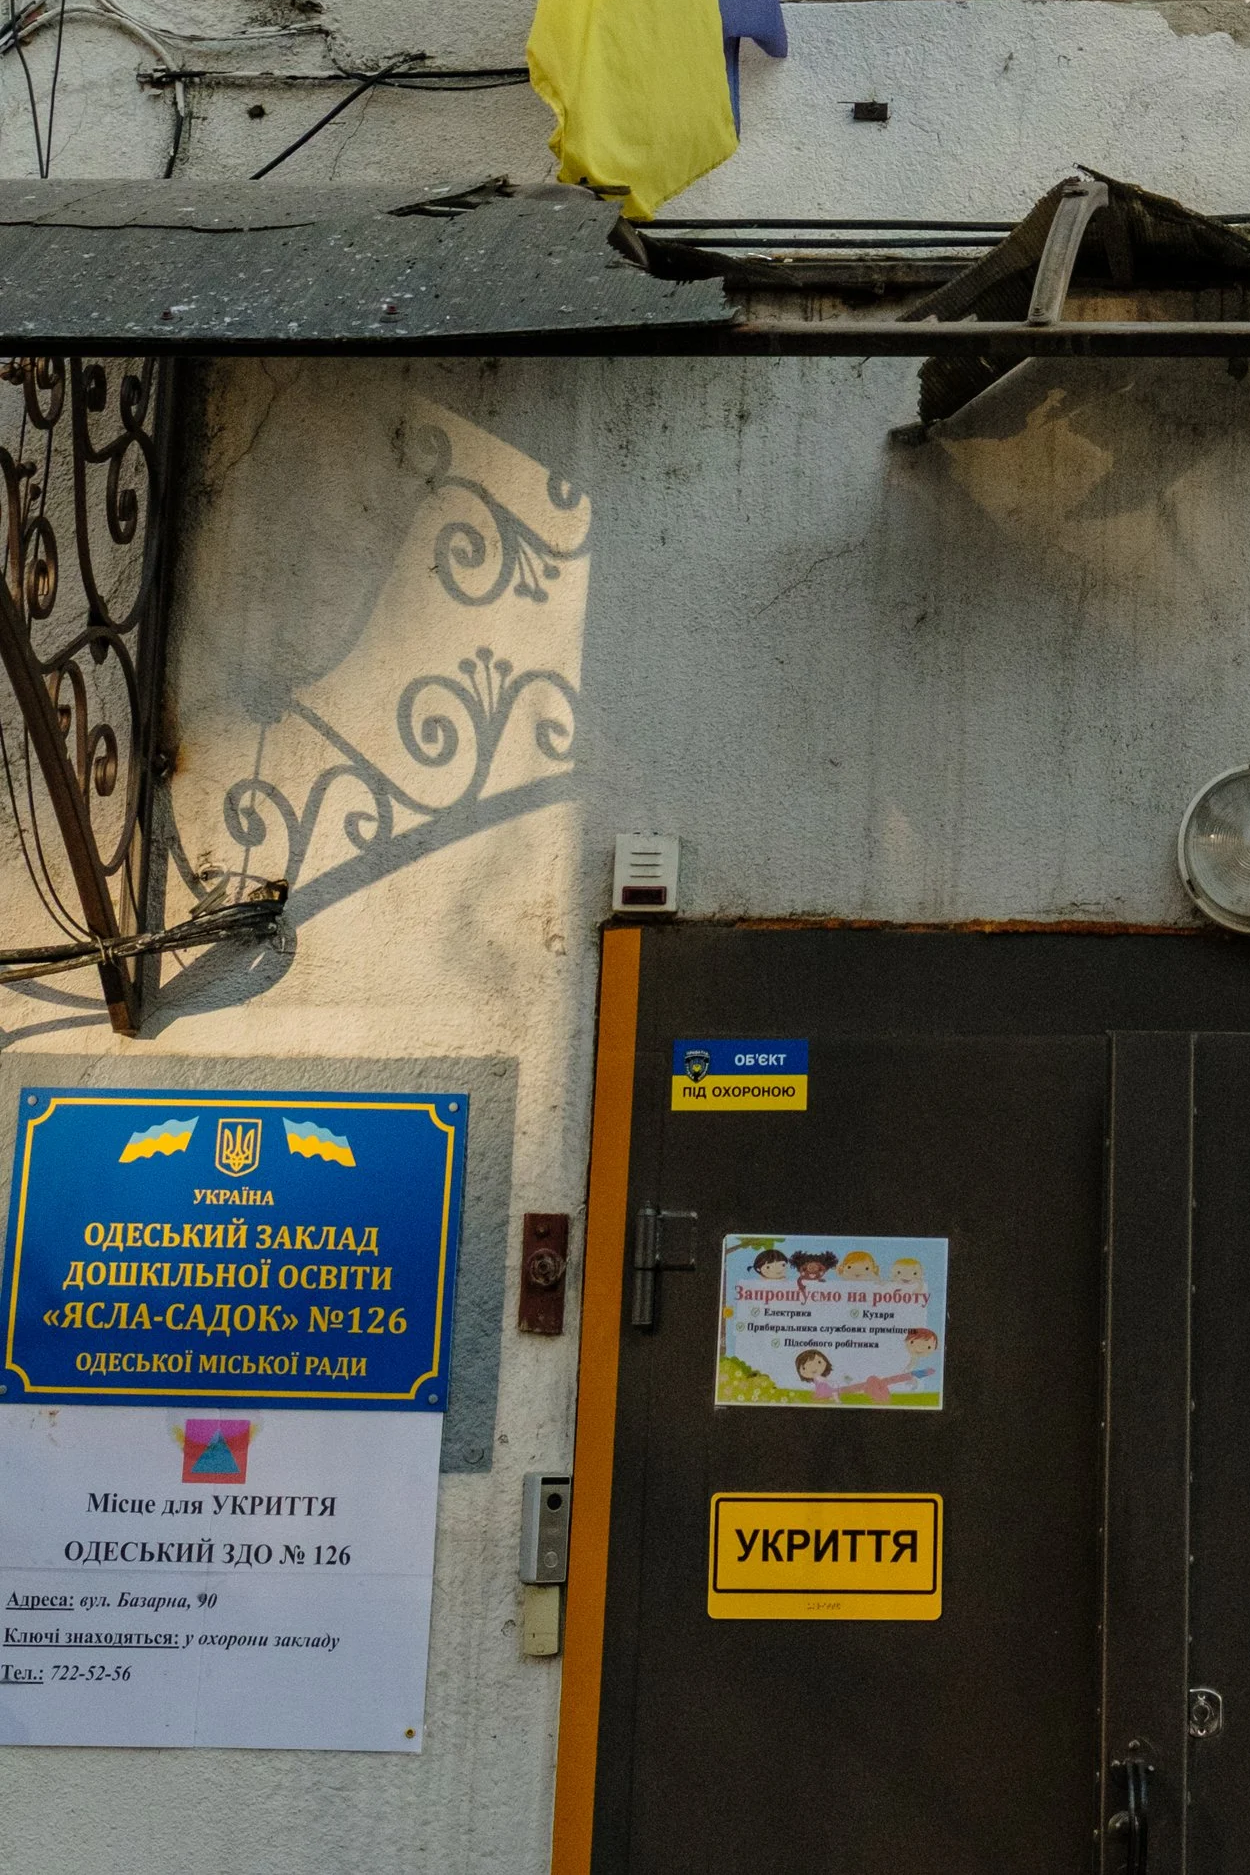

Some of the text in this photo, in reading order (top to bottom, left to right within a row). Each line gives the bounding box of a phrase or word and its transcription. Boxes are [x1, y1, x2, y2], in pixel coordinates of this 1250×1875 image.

[683, 1086, 796, 1099] ПІД ОХОРОНОЮ
[193, 1188, 275, 1207] УКРАЇНА
[84, 1218, 379, 1255] ОДЕСЬКИЙ ЗАКЛАД
[63, 1258, 393, 1291] ДОШКІЛЬНОЇ ОСВІТИ
[735, 1285, 931, 1308] Запрошуємо на роботу
[43, 1302, 408, 1337] «ЯСЛА-САДОК» №126
[763, 1308, 812, 1318] Електрика
[862, 1309, 895, 1320] Кухаря
[747, 1323, 818, 1333] Прибиральника
[819, 1324, 867, 1334] службових
[784, 1338, 880, 1349] Підсобного робітника
[75, 1350, 368, 1378] ОДЕСЬКОЇ МІСЬКОЇ РАДИ
[86, 1492, 337, 1518] Місце для УКРИТТЯ
[64, 1538, 352, 1567] ОДЕСЬКИЙ ЗДО № 126
[735, 1528, 918, 1563] УКРИТТЯ
[7, 1591, 218, 1612] Адреса: вул. Базарна, 90
[4, 1627, 340, 1652] Ключі знаходяться: у охорони закладу
[0, 1664, 132, 1682] Тел.: 722-52-56
